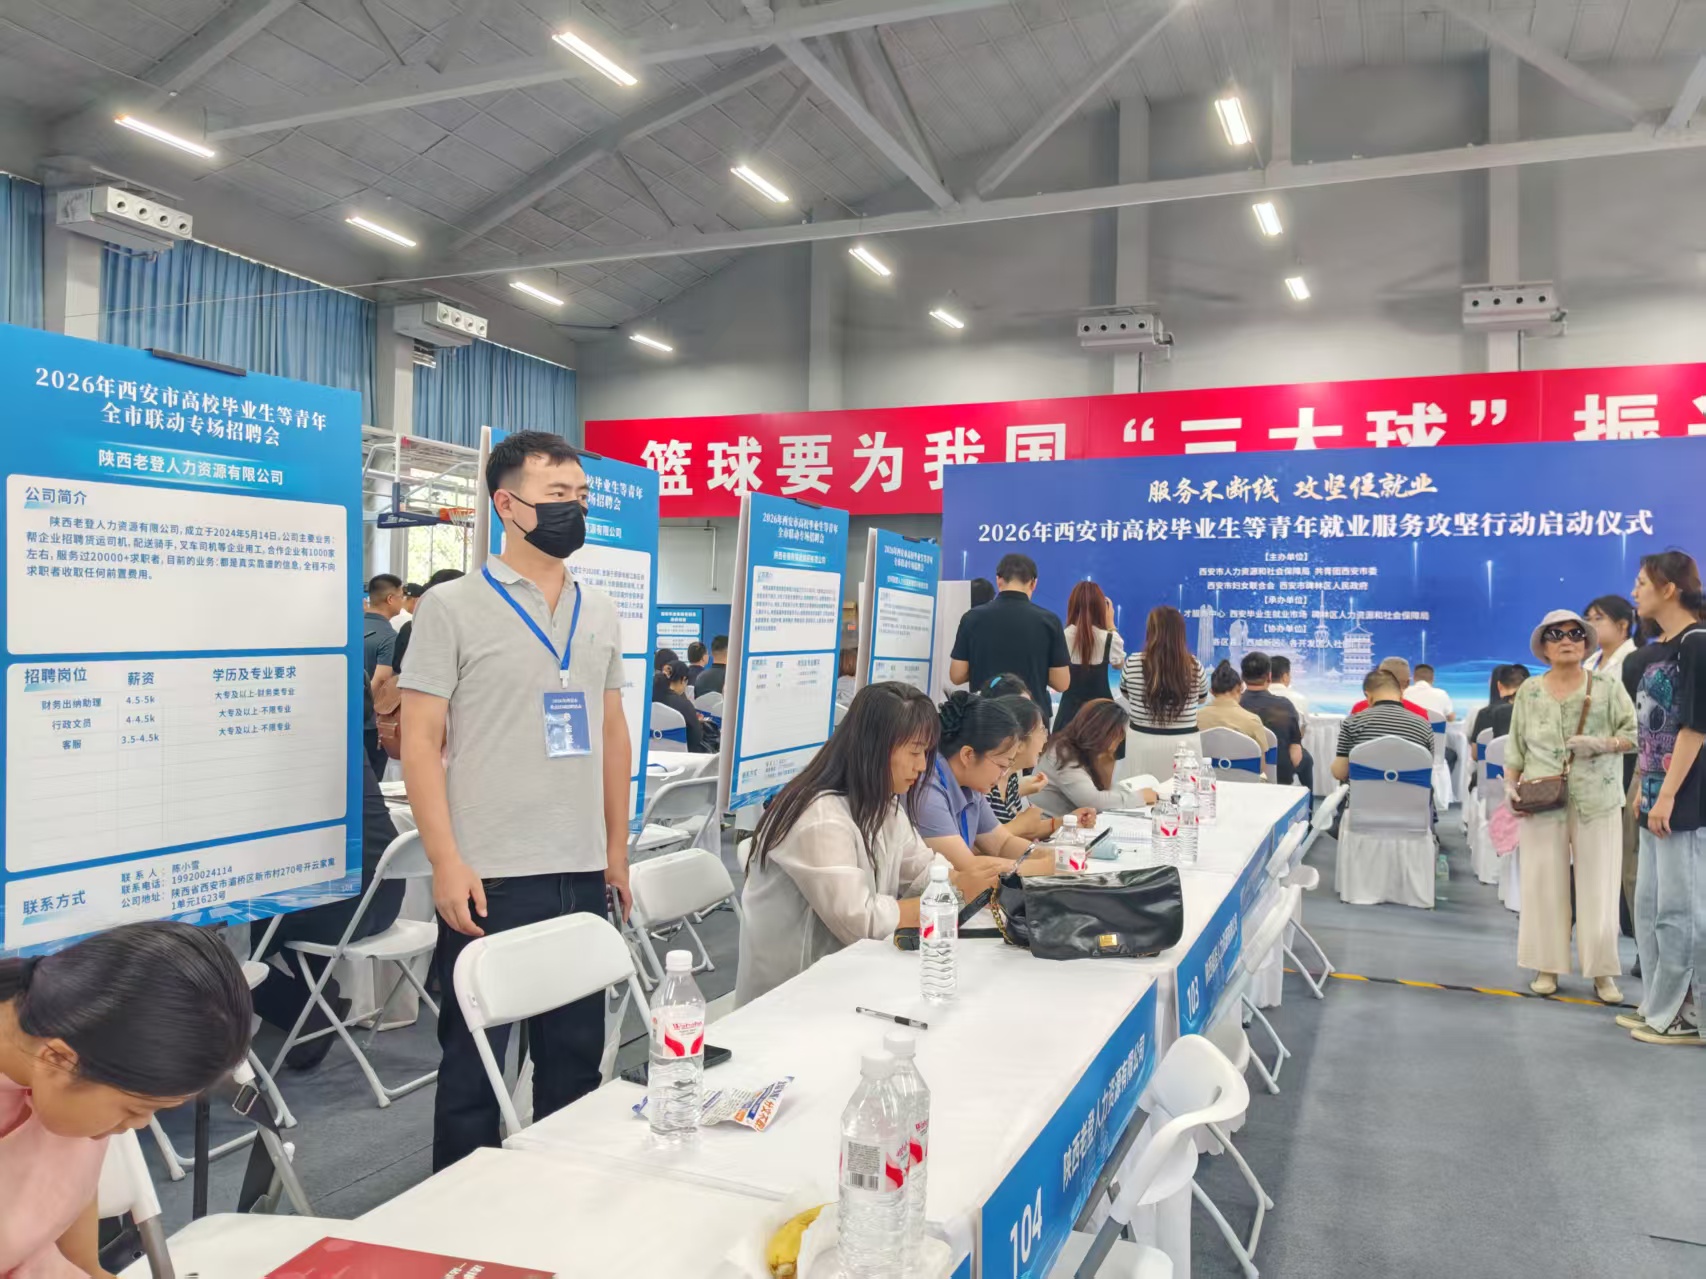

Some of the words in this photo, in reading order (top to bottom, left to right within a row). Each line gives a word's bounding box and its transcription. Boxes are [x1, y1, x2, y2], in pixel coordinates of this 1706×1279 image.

[35, 367, 327, 431] 2026年西安市高校毕业生等青年
[101, 402, 281, 446] 全市联动专场招聘会
[98, 449, 284, 486] 陕西老登人力资源有限公司
[25, 486, 87, 506] 公司简介
[1148, 475, 1279, 504] 服务不断线
[1293, 472, 1439, 500] 攻坚促就业
[978, 508, 1653, 543] 2026年西安市高校毕业生等青年就业服务攻坚行动启动仪式
[1199, 567, 1310, 576] 西安市人力资源和社会保障局
[1207, 581, 1275, 590] 西安市妇女联合会
[24, 667, 87, 684] 招聘岗位
[127, 671, 155, 686] 薪资
[212, 666, 297, 681] 学历及专业要求
[41, 697, 102, 711] 财务出纳助理
[126, 695, 155, 706] 4.5-5k
[52, 718, 92, 731] 行政文员
[126, 714, 155, 724] 4-4.5k
[62, 739, 82, 750] 客服
[121, 733, 160, 744] 3.5-4.5k
[172, 865, 233, 885] 19920024114
[23, 890, 86, 915] 联系方式
[172, 891, 227, 910] 1单元1623号
[1010, 1185, 1042, 1279] 104
